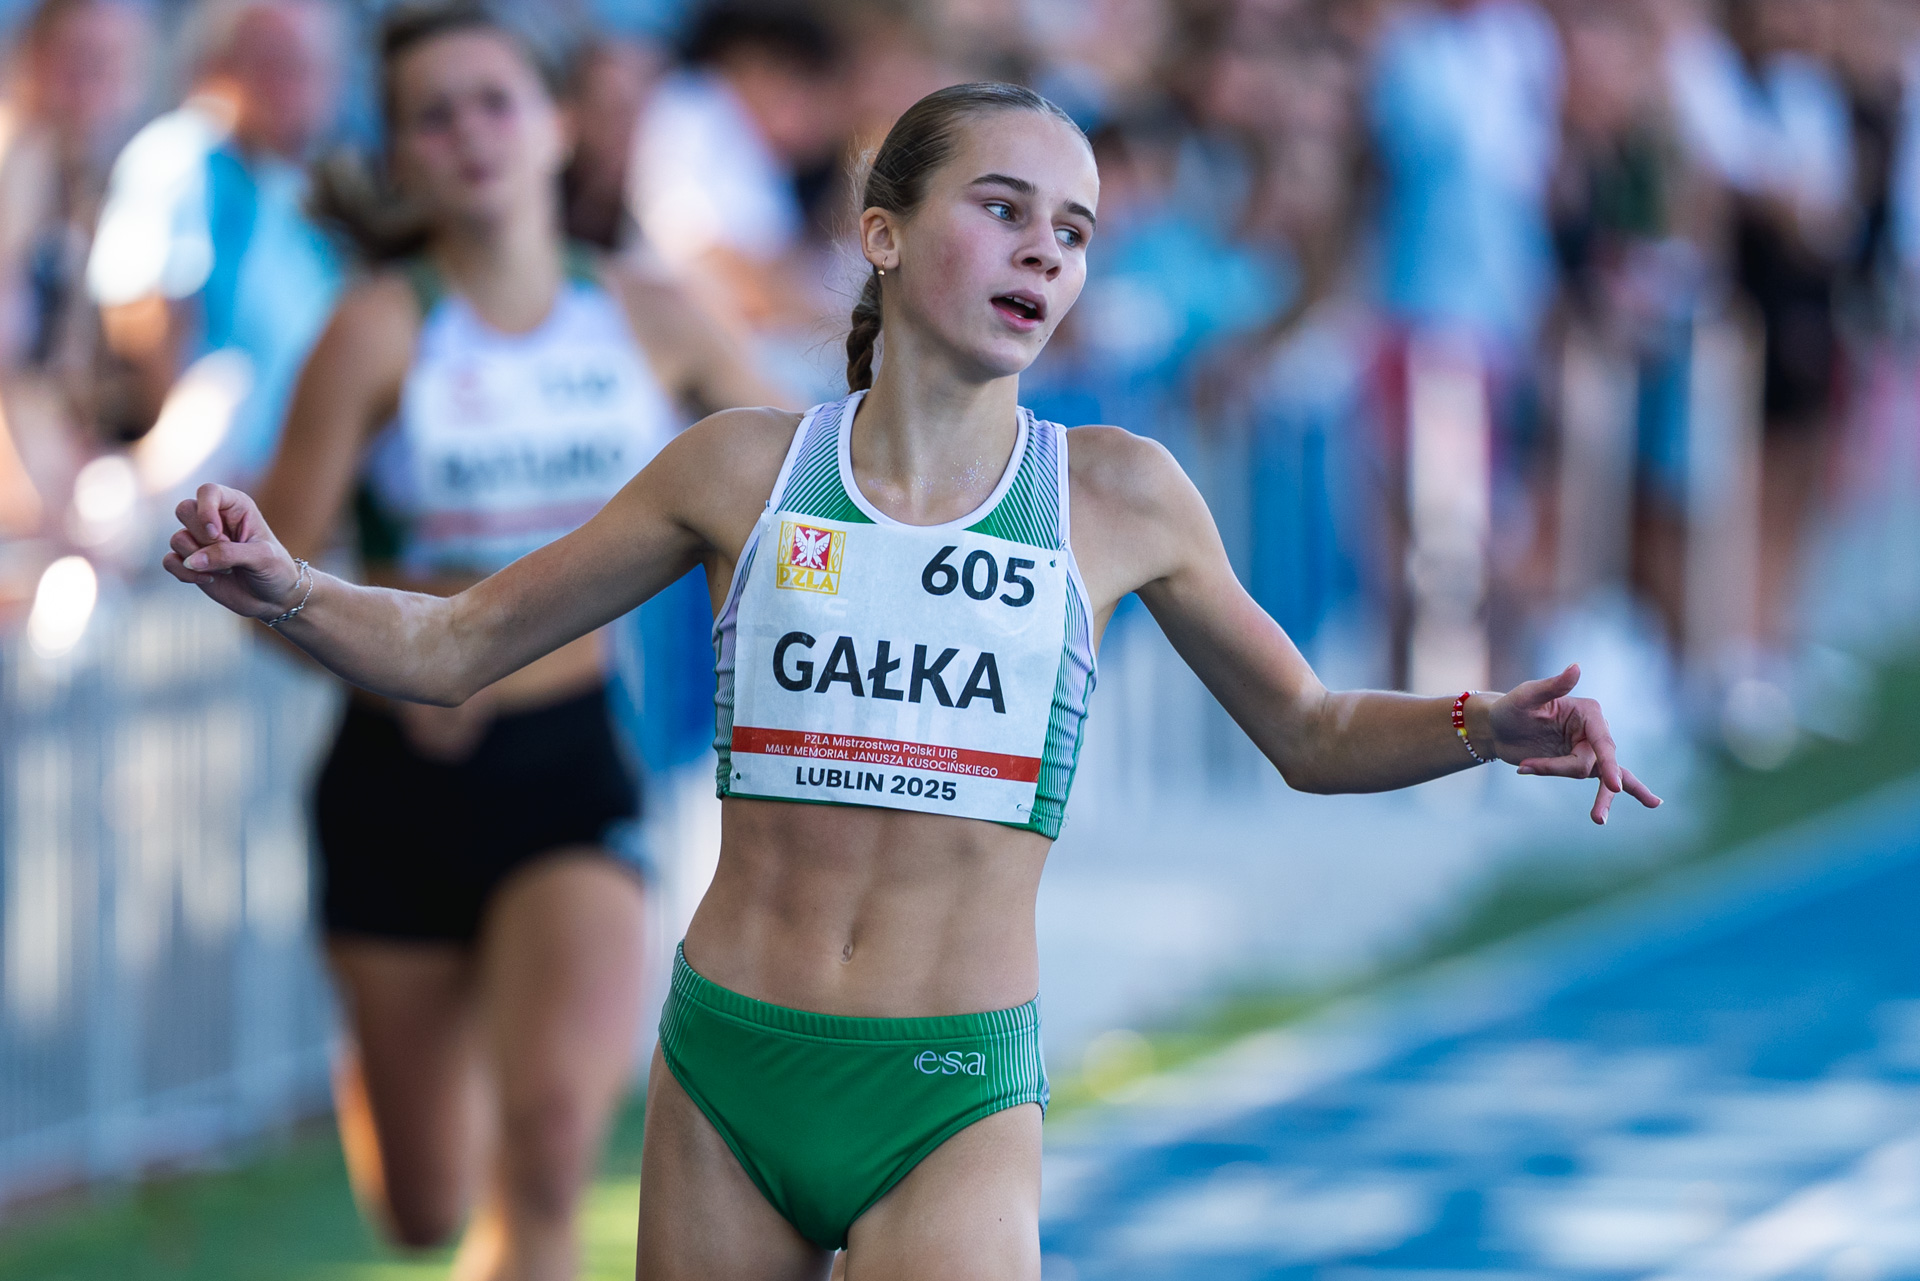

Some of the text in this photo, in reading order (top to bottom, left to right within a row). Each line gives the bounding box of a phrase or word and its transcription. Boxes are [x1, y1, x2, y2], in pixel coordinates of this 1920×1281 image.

[779, 567, 835, 591] PZLA
[921, 545, 1035, 607] 605
[772, 631, 1006, 714] GAŁKA
[765, 743, 999, 777] MAŁY MEMORIAŁ JANUSZA KUSOCIŃSKIEGO
[804, 733, 958, 760] PZLA Mistrzostwa Polski U16
[795, 766, 957, 801] LUBLIN 2025
[913, 1050, 986, 1076] esa
